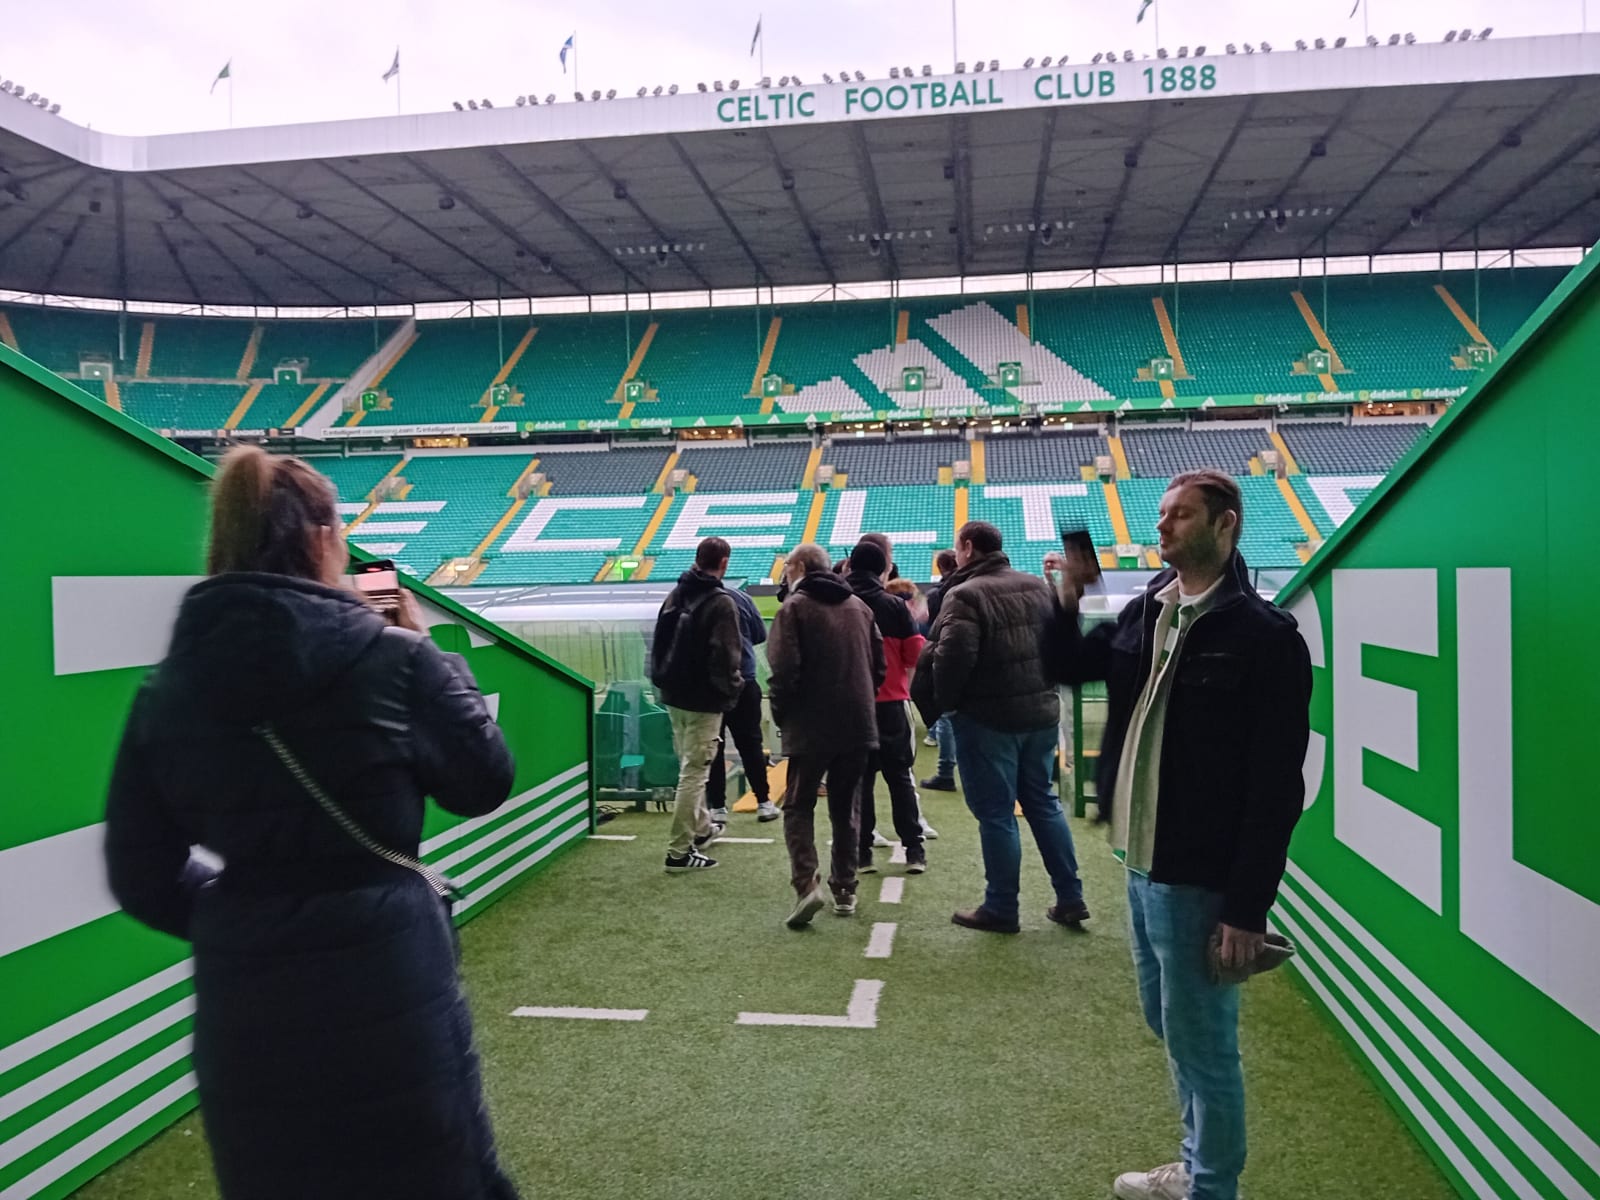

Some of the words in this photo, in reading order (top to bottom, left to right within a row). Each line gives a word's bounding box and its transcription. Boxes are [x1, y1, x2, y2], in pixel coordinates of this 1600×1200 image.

[717, 92, 815, 123] CELTIC
[845, 78, 1004, 114] FOOTBALL
[1034, 69, 1116, 101] CLUB
[1143, 64, 1217, 94] 1888
[1266, 393, 1302, 403] dafabet
[1318, 391, 1354, 401] dafabet
[1370, 390, 1407, 400] dafabet
[535, 420, 566, 430] dafabet
[588, 420, 619, 428] dafabet
[641, 418, 672, 427] dafabet
